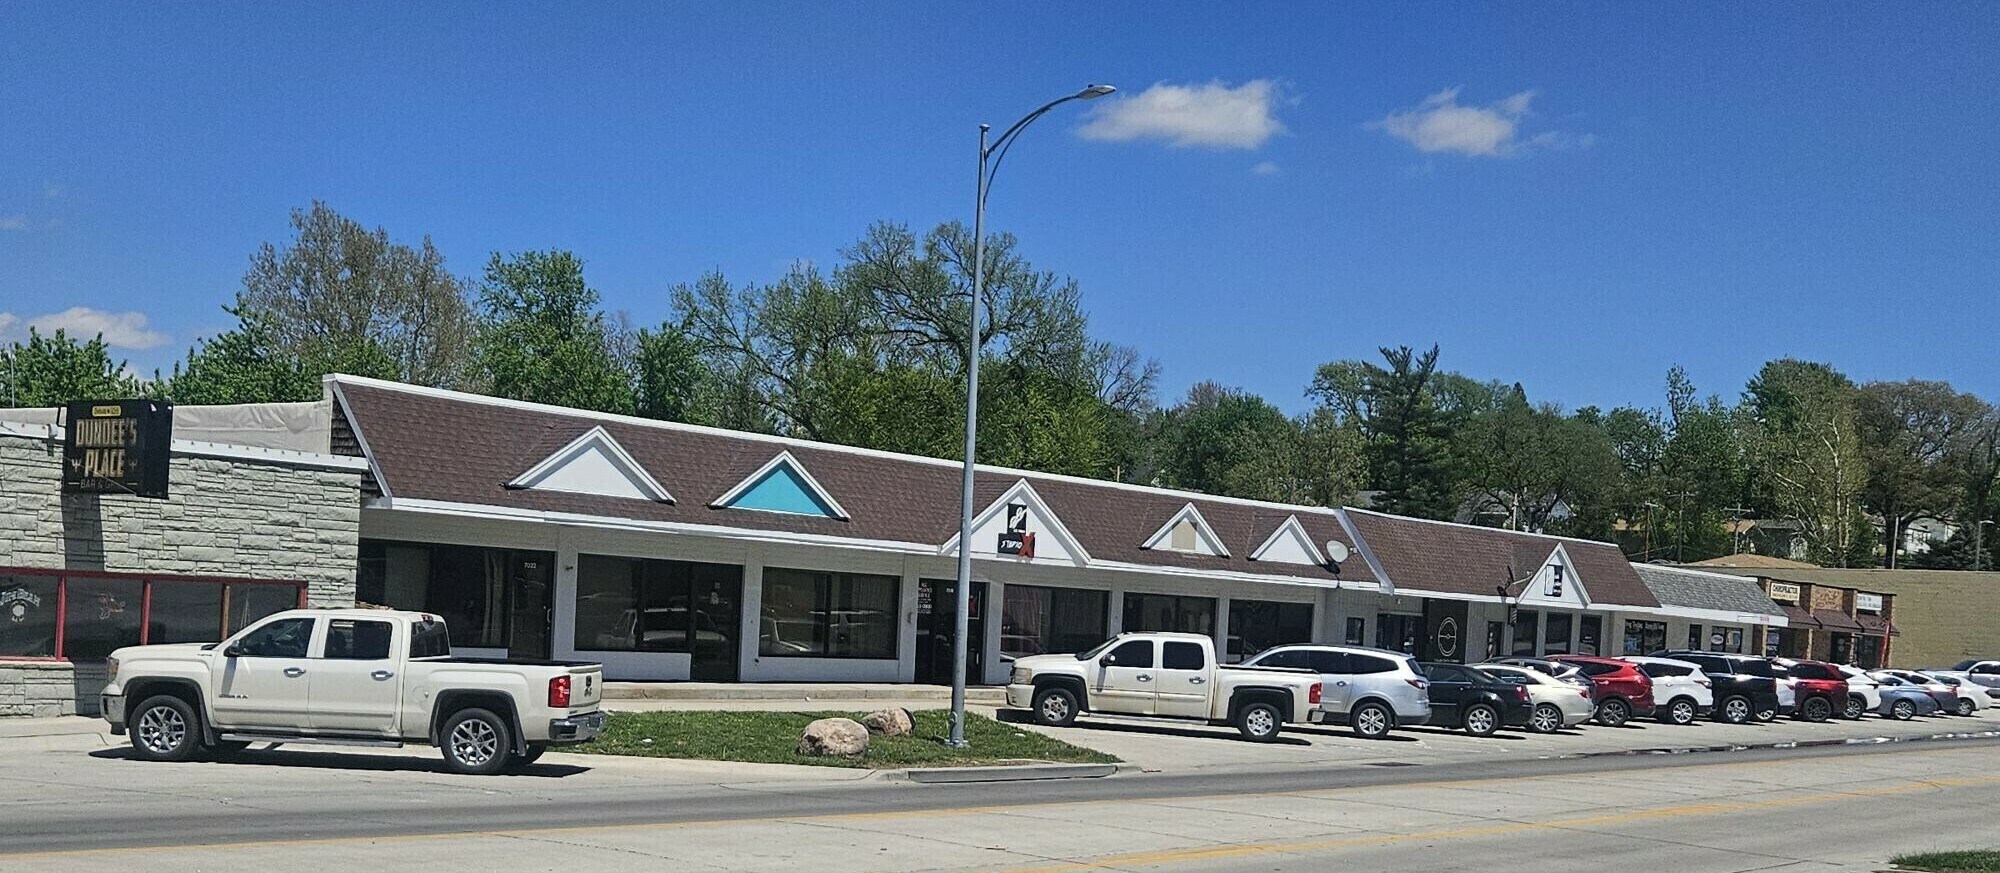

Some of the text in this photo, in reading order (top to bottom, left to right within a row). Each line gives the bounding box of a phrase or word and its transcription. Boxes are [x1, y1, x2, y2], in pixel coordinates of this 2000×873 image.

[76, 418, 138, 447] DUNDEE'S
[84, 448, 126, 477] PLACE
[80, 479, 96, 489] BAR
